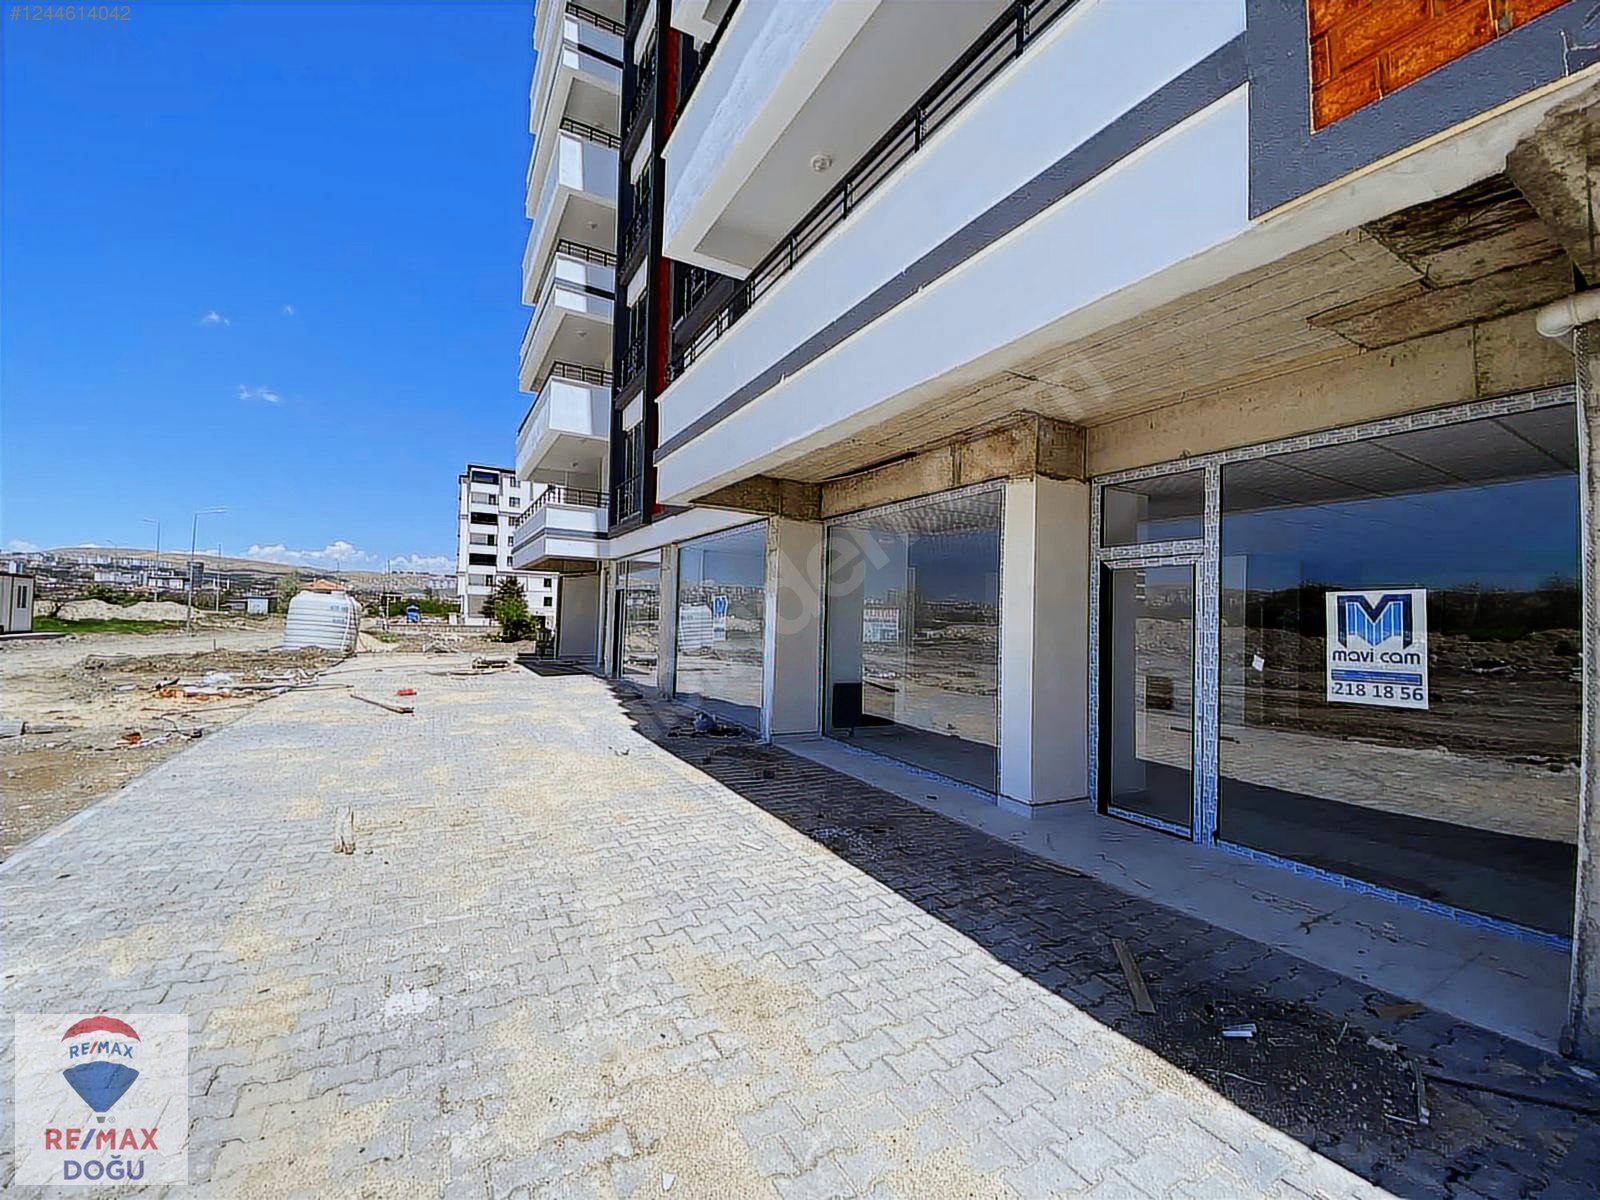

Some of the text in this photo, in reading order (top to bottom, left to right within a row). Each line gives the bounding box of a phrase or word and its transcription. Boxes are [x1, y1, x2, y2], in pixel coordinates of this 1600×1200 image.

[1332, 648, 1421, 665] mavi cam
[1333, 682, 1424, 701] 218 18 56
